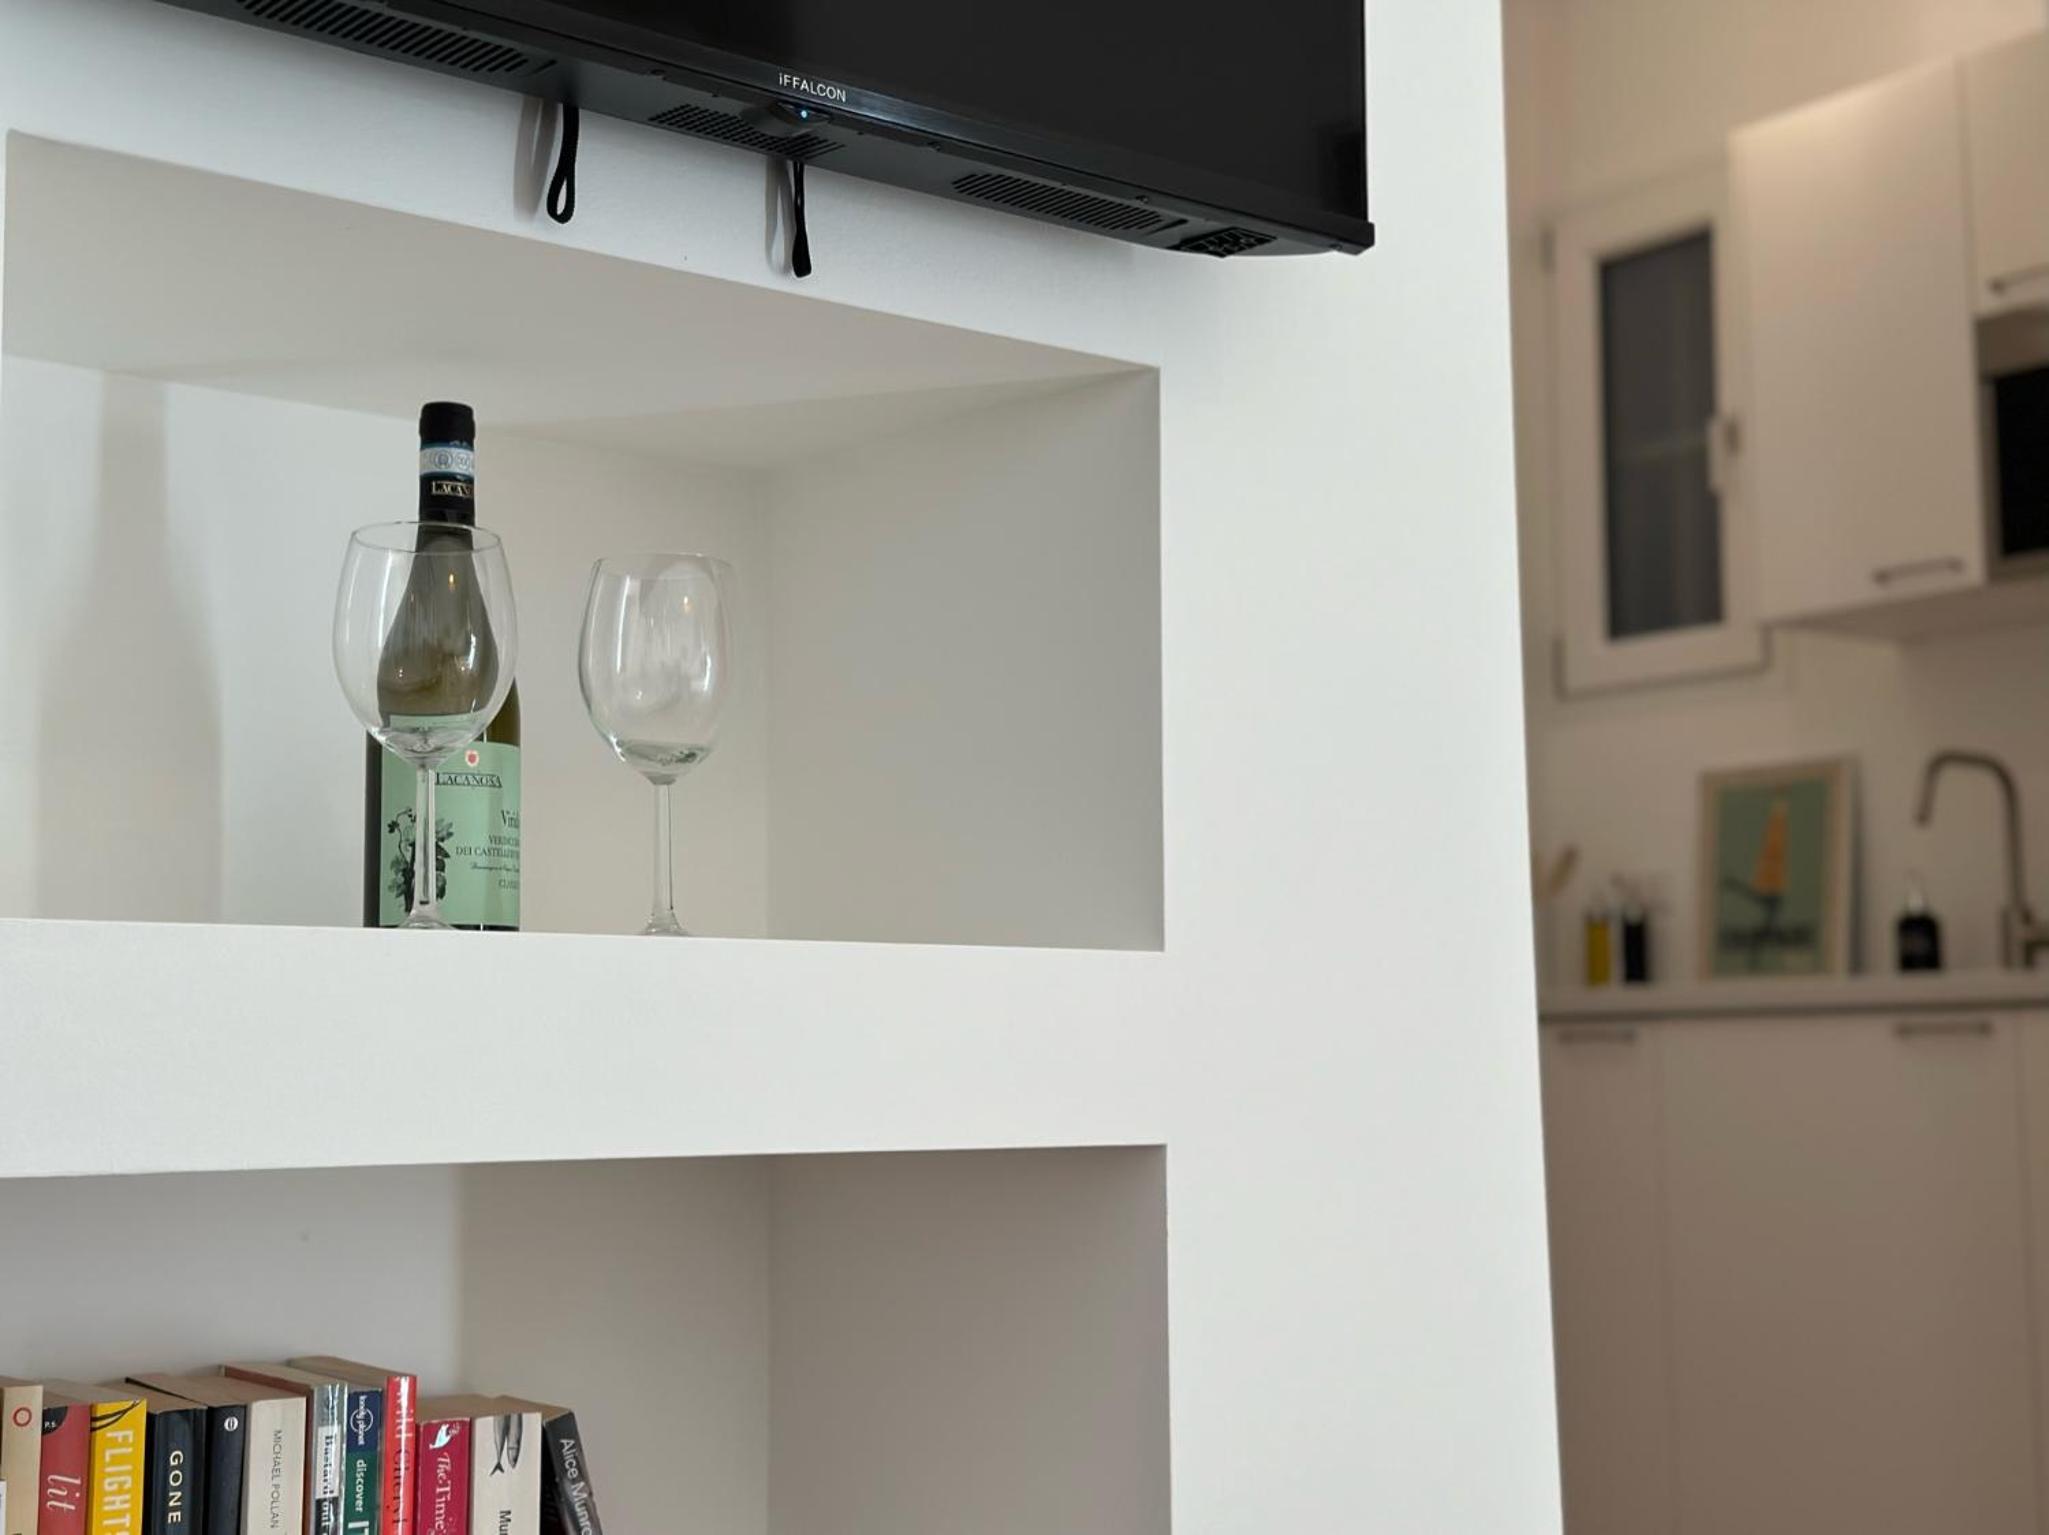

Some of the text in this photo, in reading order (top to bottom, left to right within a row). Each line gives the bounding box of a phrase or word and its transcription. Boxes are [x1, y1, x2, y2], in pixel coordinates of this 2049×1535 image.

[102, 1430, 134, 1535] FLIGHT
[168, 1450, 184, 1524] GONE
[270, 1430, 282, 1528] MICHAEL POLLAN
[355, 1459, 367, 1512] discover
[560, 1439, 579, 1480] Alice
[47, 1474, 81, 1512] lit
